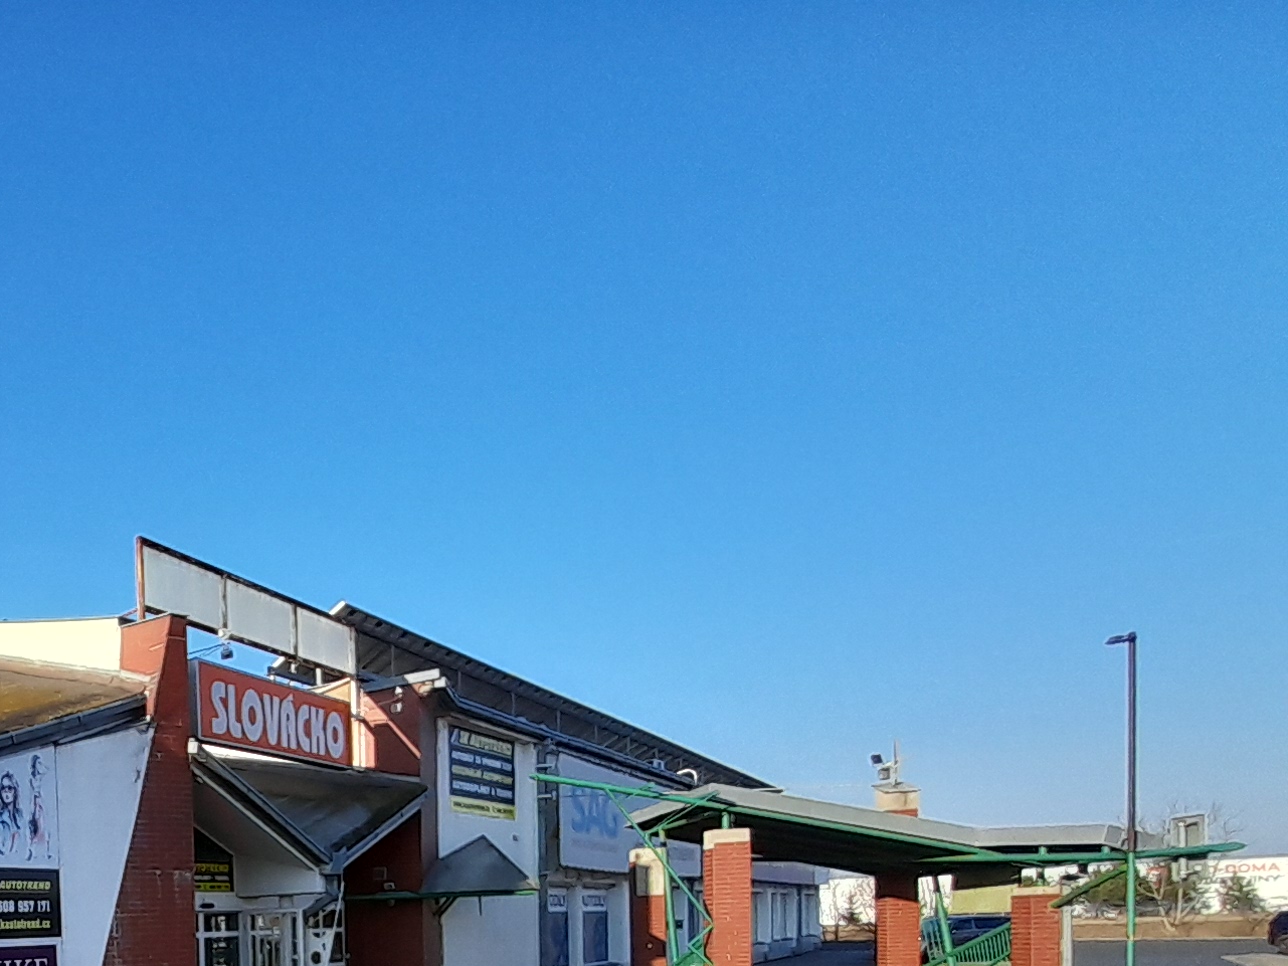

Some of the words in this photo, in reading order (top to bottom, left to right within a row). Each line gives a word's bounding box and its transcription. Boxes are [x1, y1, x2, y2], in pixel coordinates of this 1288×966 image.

[212, 681, 344, 759] SLOVÁCKO
[17, 900, 35, 913] 957
[37, 900, 51, 913] 171
